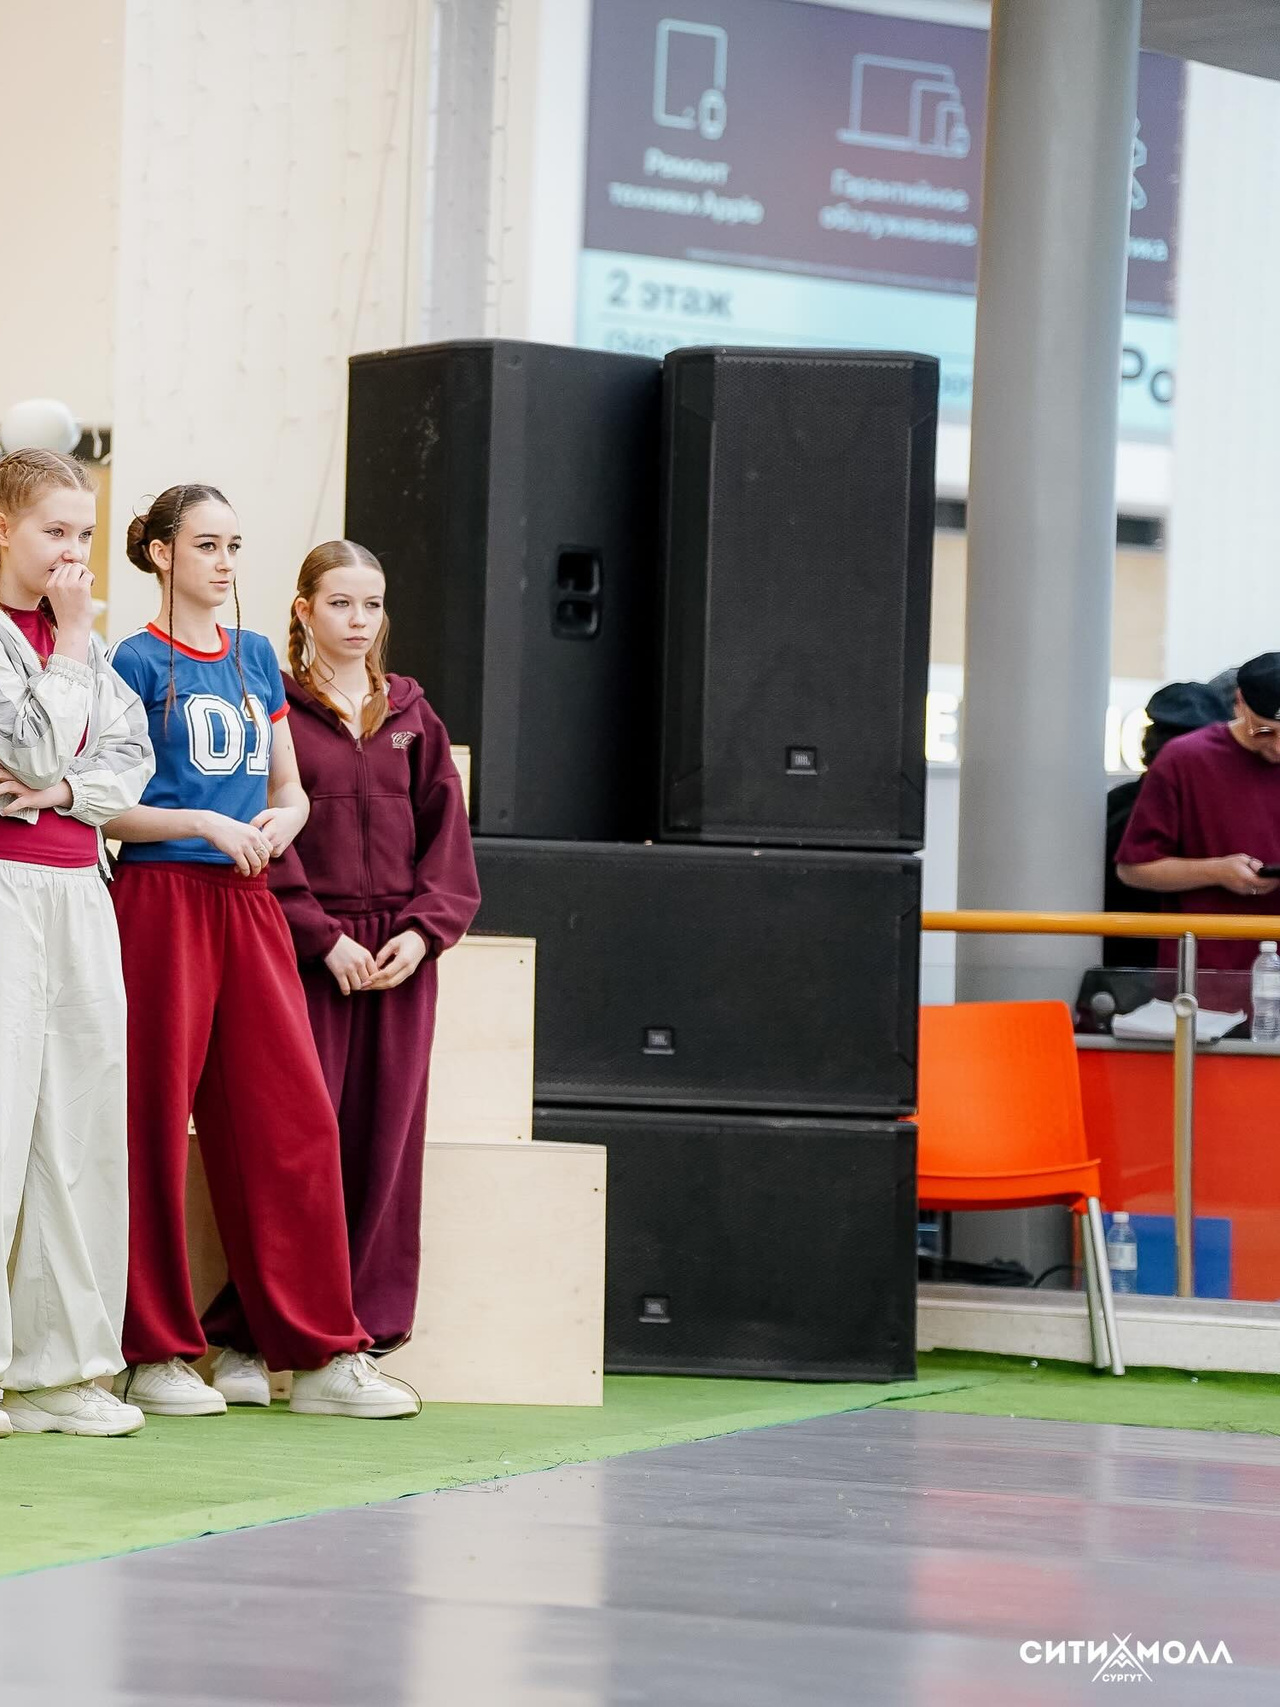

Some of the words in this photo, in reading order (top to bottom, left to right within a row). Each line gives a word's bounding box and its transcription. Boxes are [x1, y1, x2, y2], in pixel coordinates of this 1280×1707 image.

[606, 268, 632, 308] 2
[640, 280, 734, 319] этаж
[183, 693, 271, 776] 01
